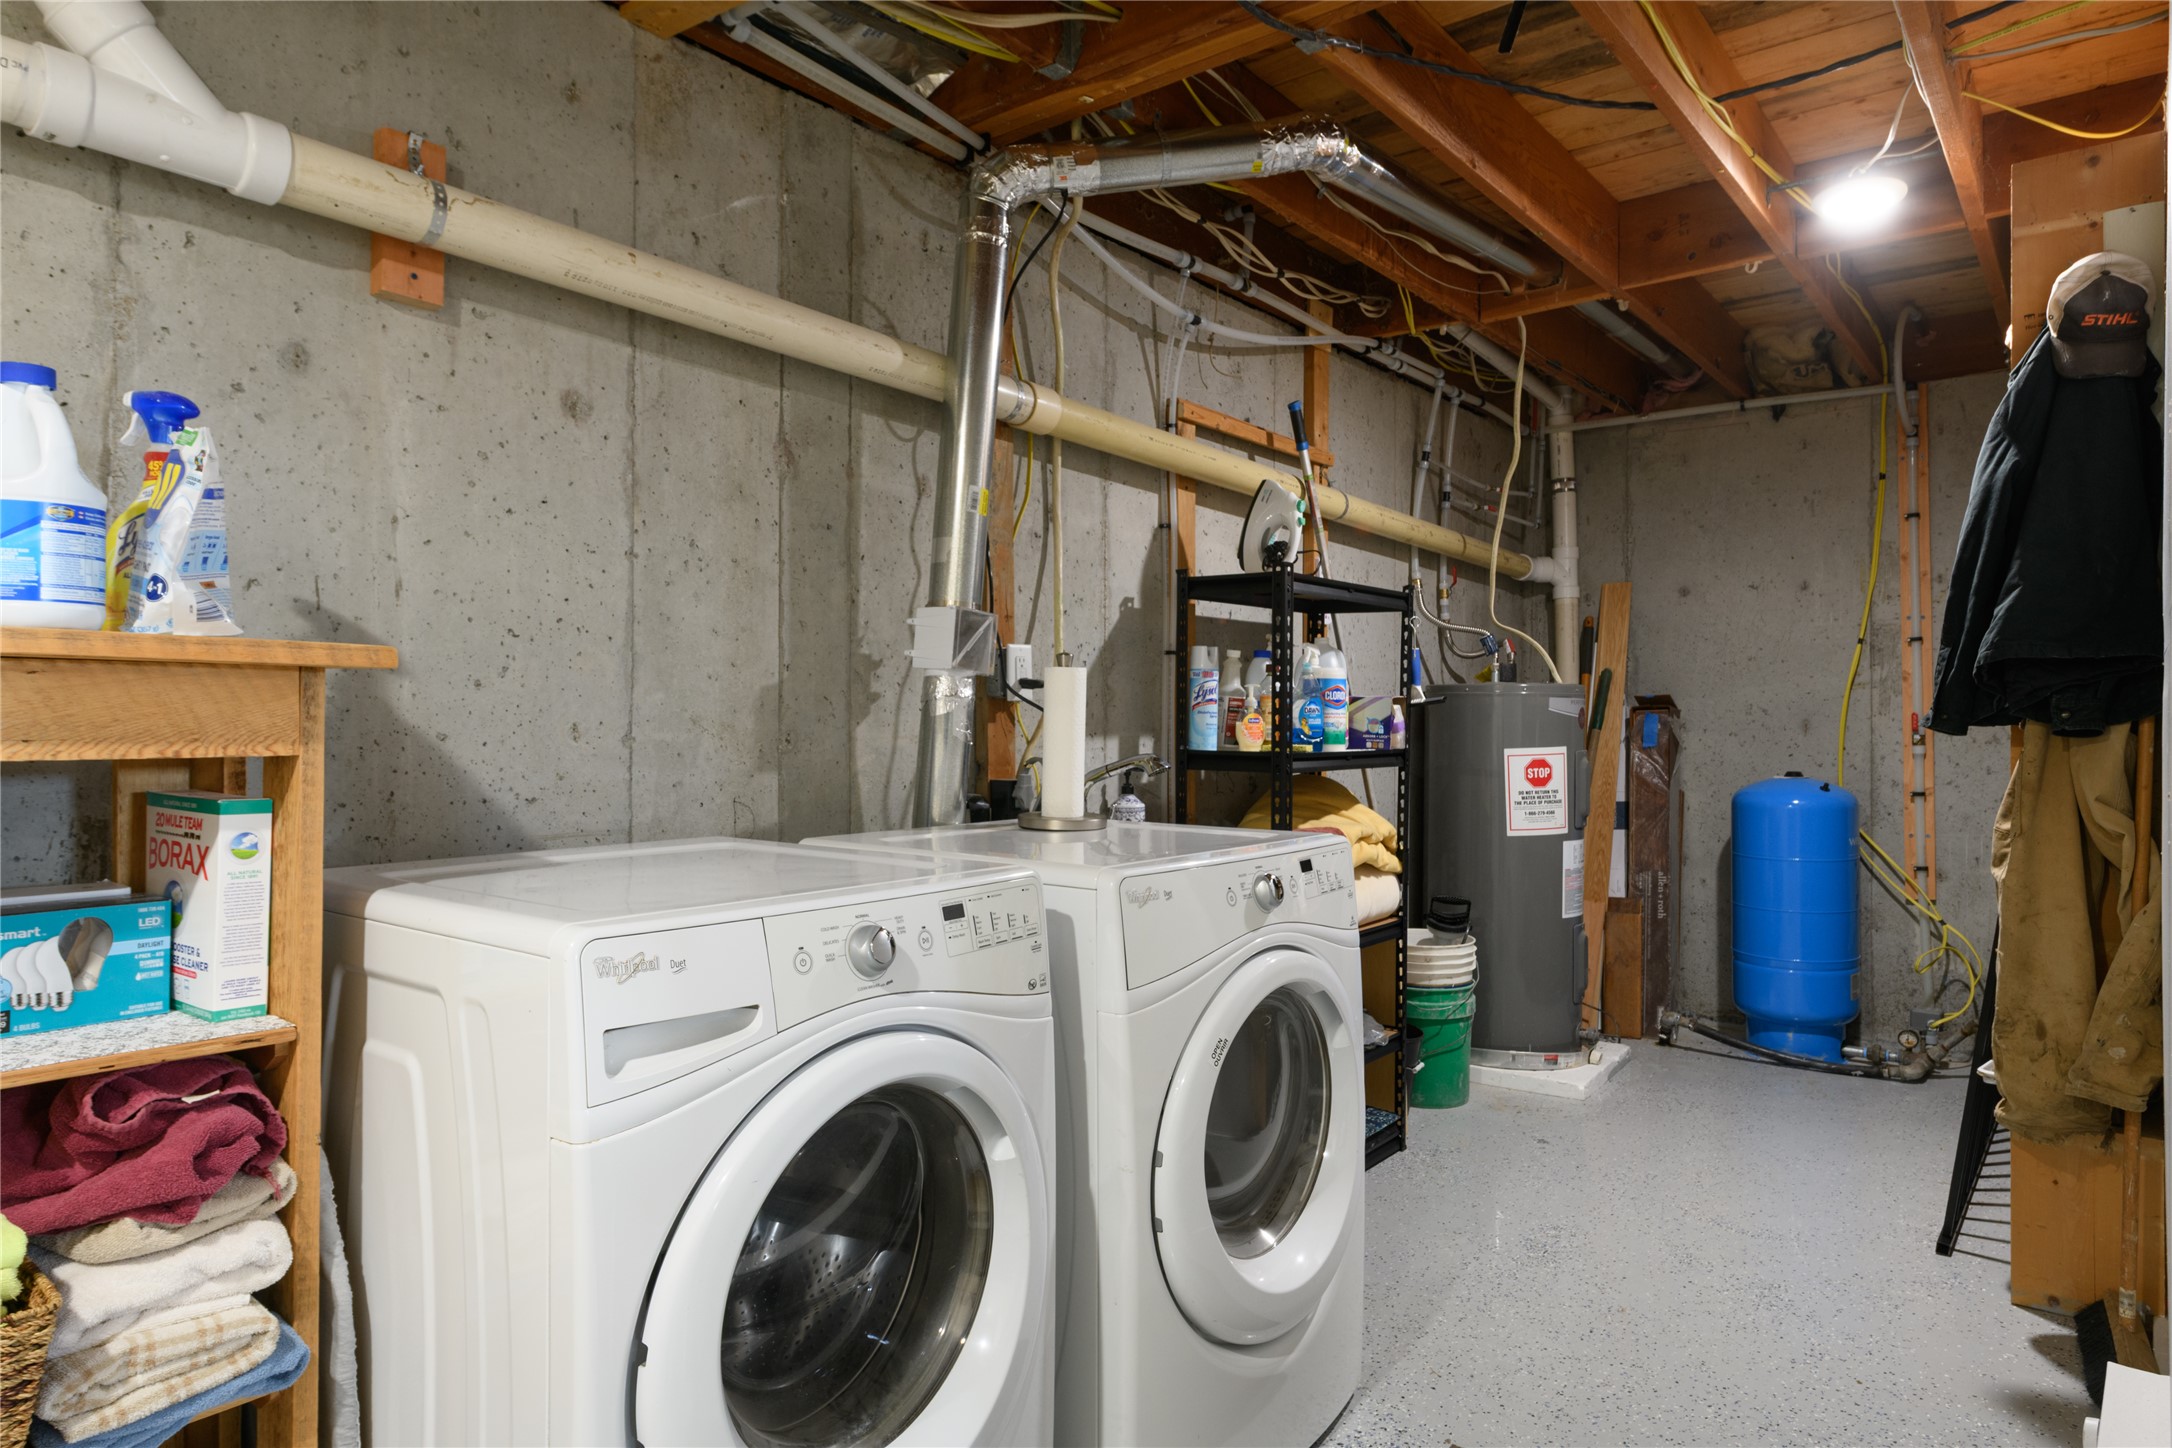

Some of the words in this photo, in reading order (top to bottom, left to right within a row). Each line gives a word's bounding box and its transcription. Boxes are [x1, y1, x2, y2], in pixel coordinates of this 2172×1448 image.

[2080, 312, 2139, 327] STIHL
[1193, 682, 1218, 702] Lysol
[1324, 691, 1346, 701] CLORO
[1527, 767, 1550, 778] STOP
[155, 812, 164, 827] 20
[165, 814, 183, 828] MULE
[184, 816, 203, 831] TEAM
[149, 836, 209, 881] BORAX
[1657, 871, 1667, 892] allen
[1657, 900, 1667, 919] roth
[138, 917, 161, 927] LED
[137, 940, 164, 949] DAYLIGHT
[181, 956, 208, 971] CLEANER
[593, 953, 661, 984] Whirlpool
[669, 959, 686, 969] Duet
[19, 1021, 40, 1031] BULBS
[1211, 1037, 1223, 1060] OPEN
[1214, 1038, 1229, 1067] OUVRIR
